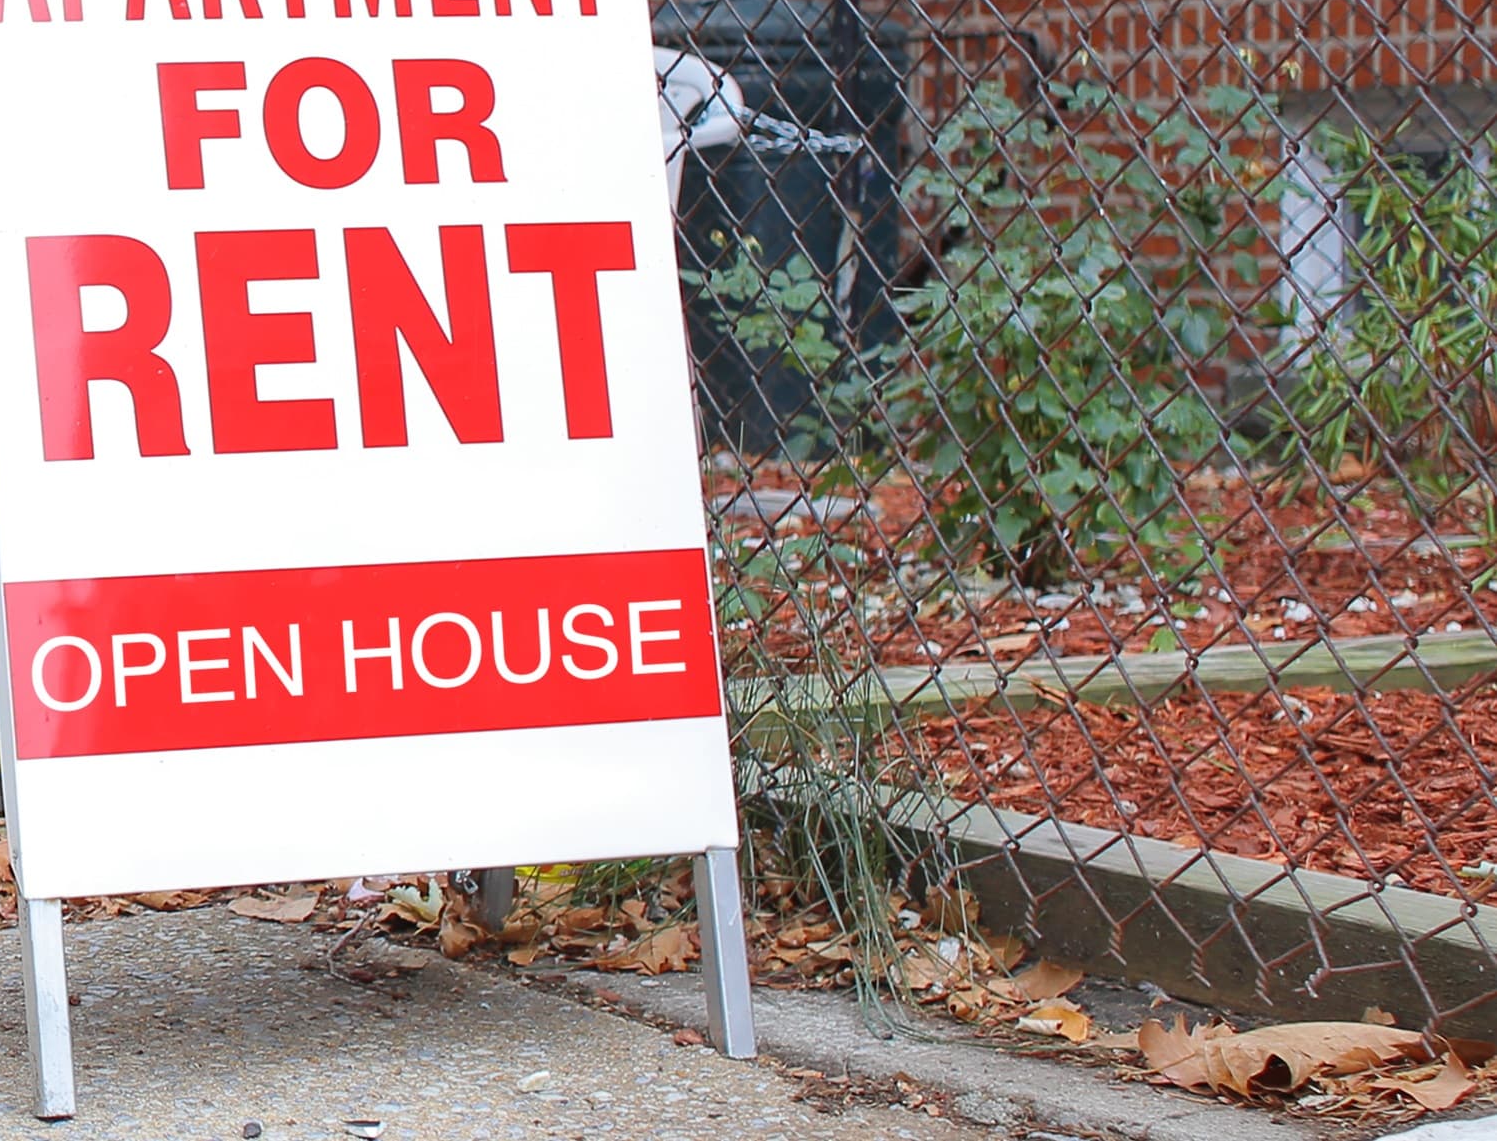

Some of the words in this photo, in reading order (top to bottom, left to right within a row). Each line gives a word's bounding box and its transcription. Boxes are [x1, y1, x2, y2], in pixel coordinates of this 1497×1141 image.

[158, 57, 507, 190] FOR
[27, 222, 636, 460] RENT
[31, 624, 303, 711] OPEN
[343, 600, 685, 692] HOUSE
